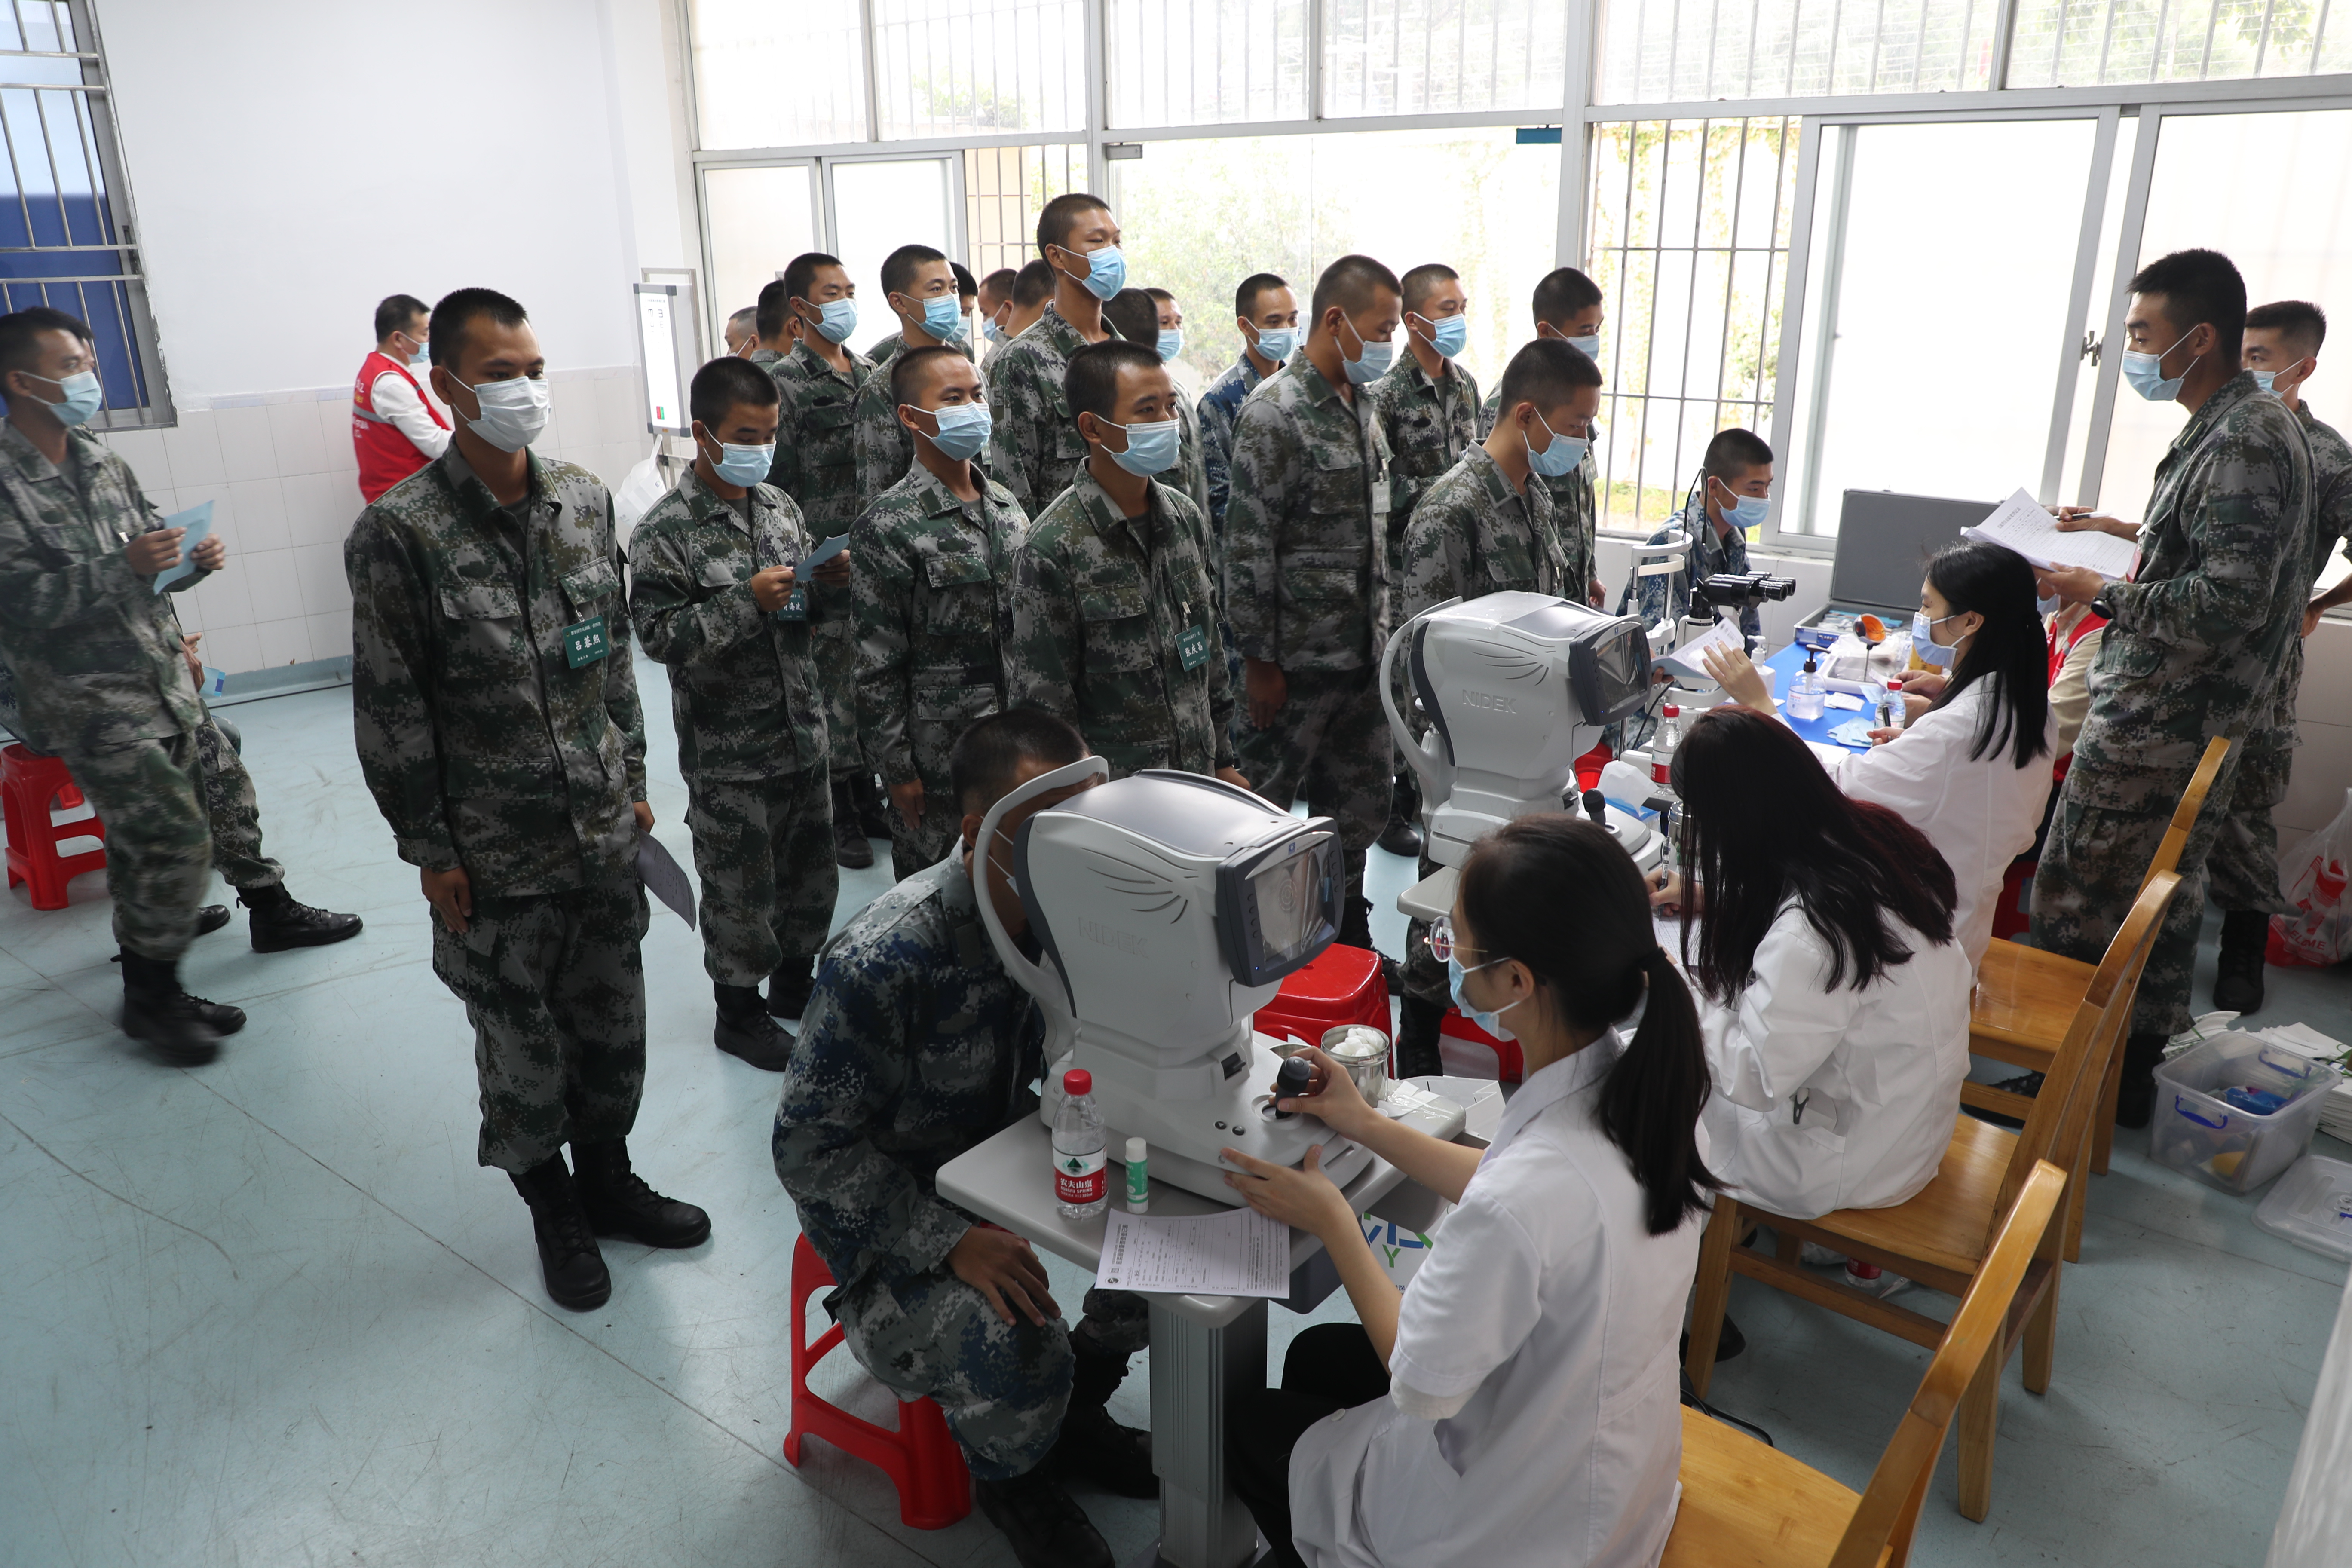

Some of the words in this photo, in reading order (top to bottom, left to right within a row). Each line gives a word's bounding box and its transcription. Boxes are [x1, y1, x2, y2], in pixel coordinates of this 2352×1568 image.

[1462, 689, 1517, 714] NIDEK
[1078, 917, 1149, 959] NIDEK
[1060, 1178, 1093, 1189] 农夫山泉
